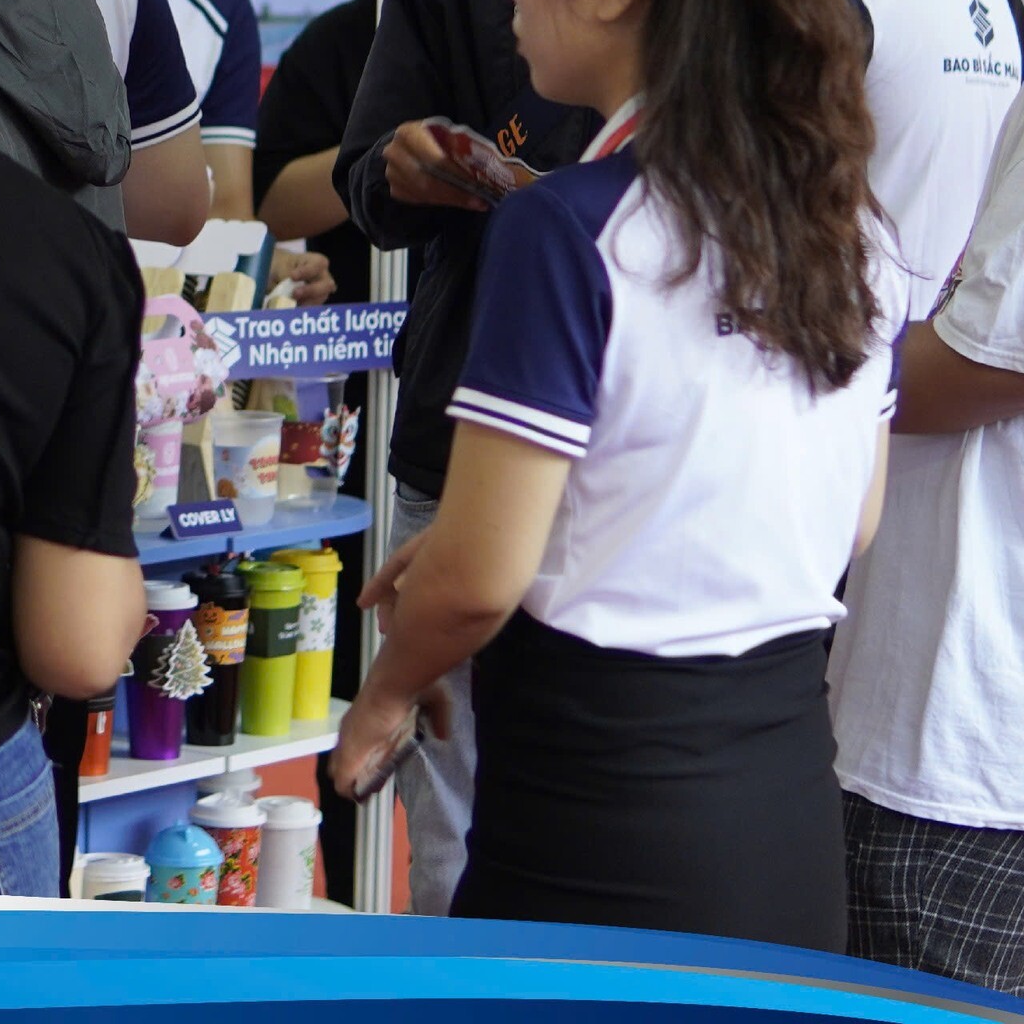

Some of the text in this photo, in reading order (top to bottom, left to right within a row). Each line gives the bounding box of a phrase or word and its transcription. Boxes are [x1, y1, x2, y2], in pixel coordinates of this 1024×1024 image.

[943, 57, 971, 73] BAO
[235, 308, 407, 339] Trao chất lượng
[249, 340, 308, 369] Nhận
